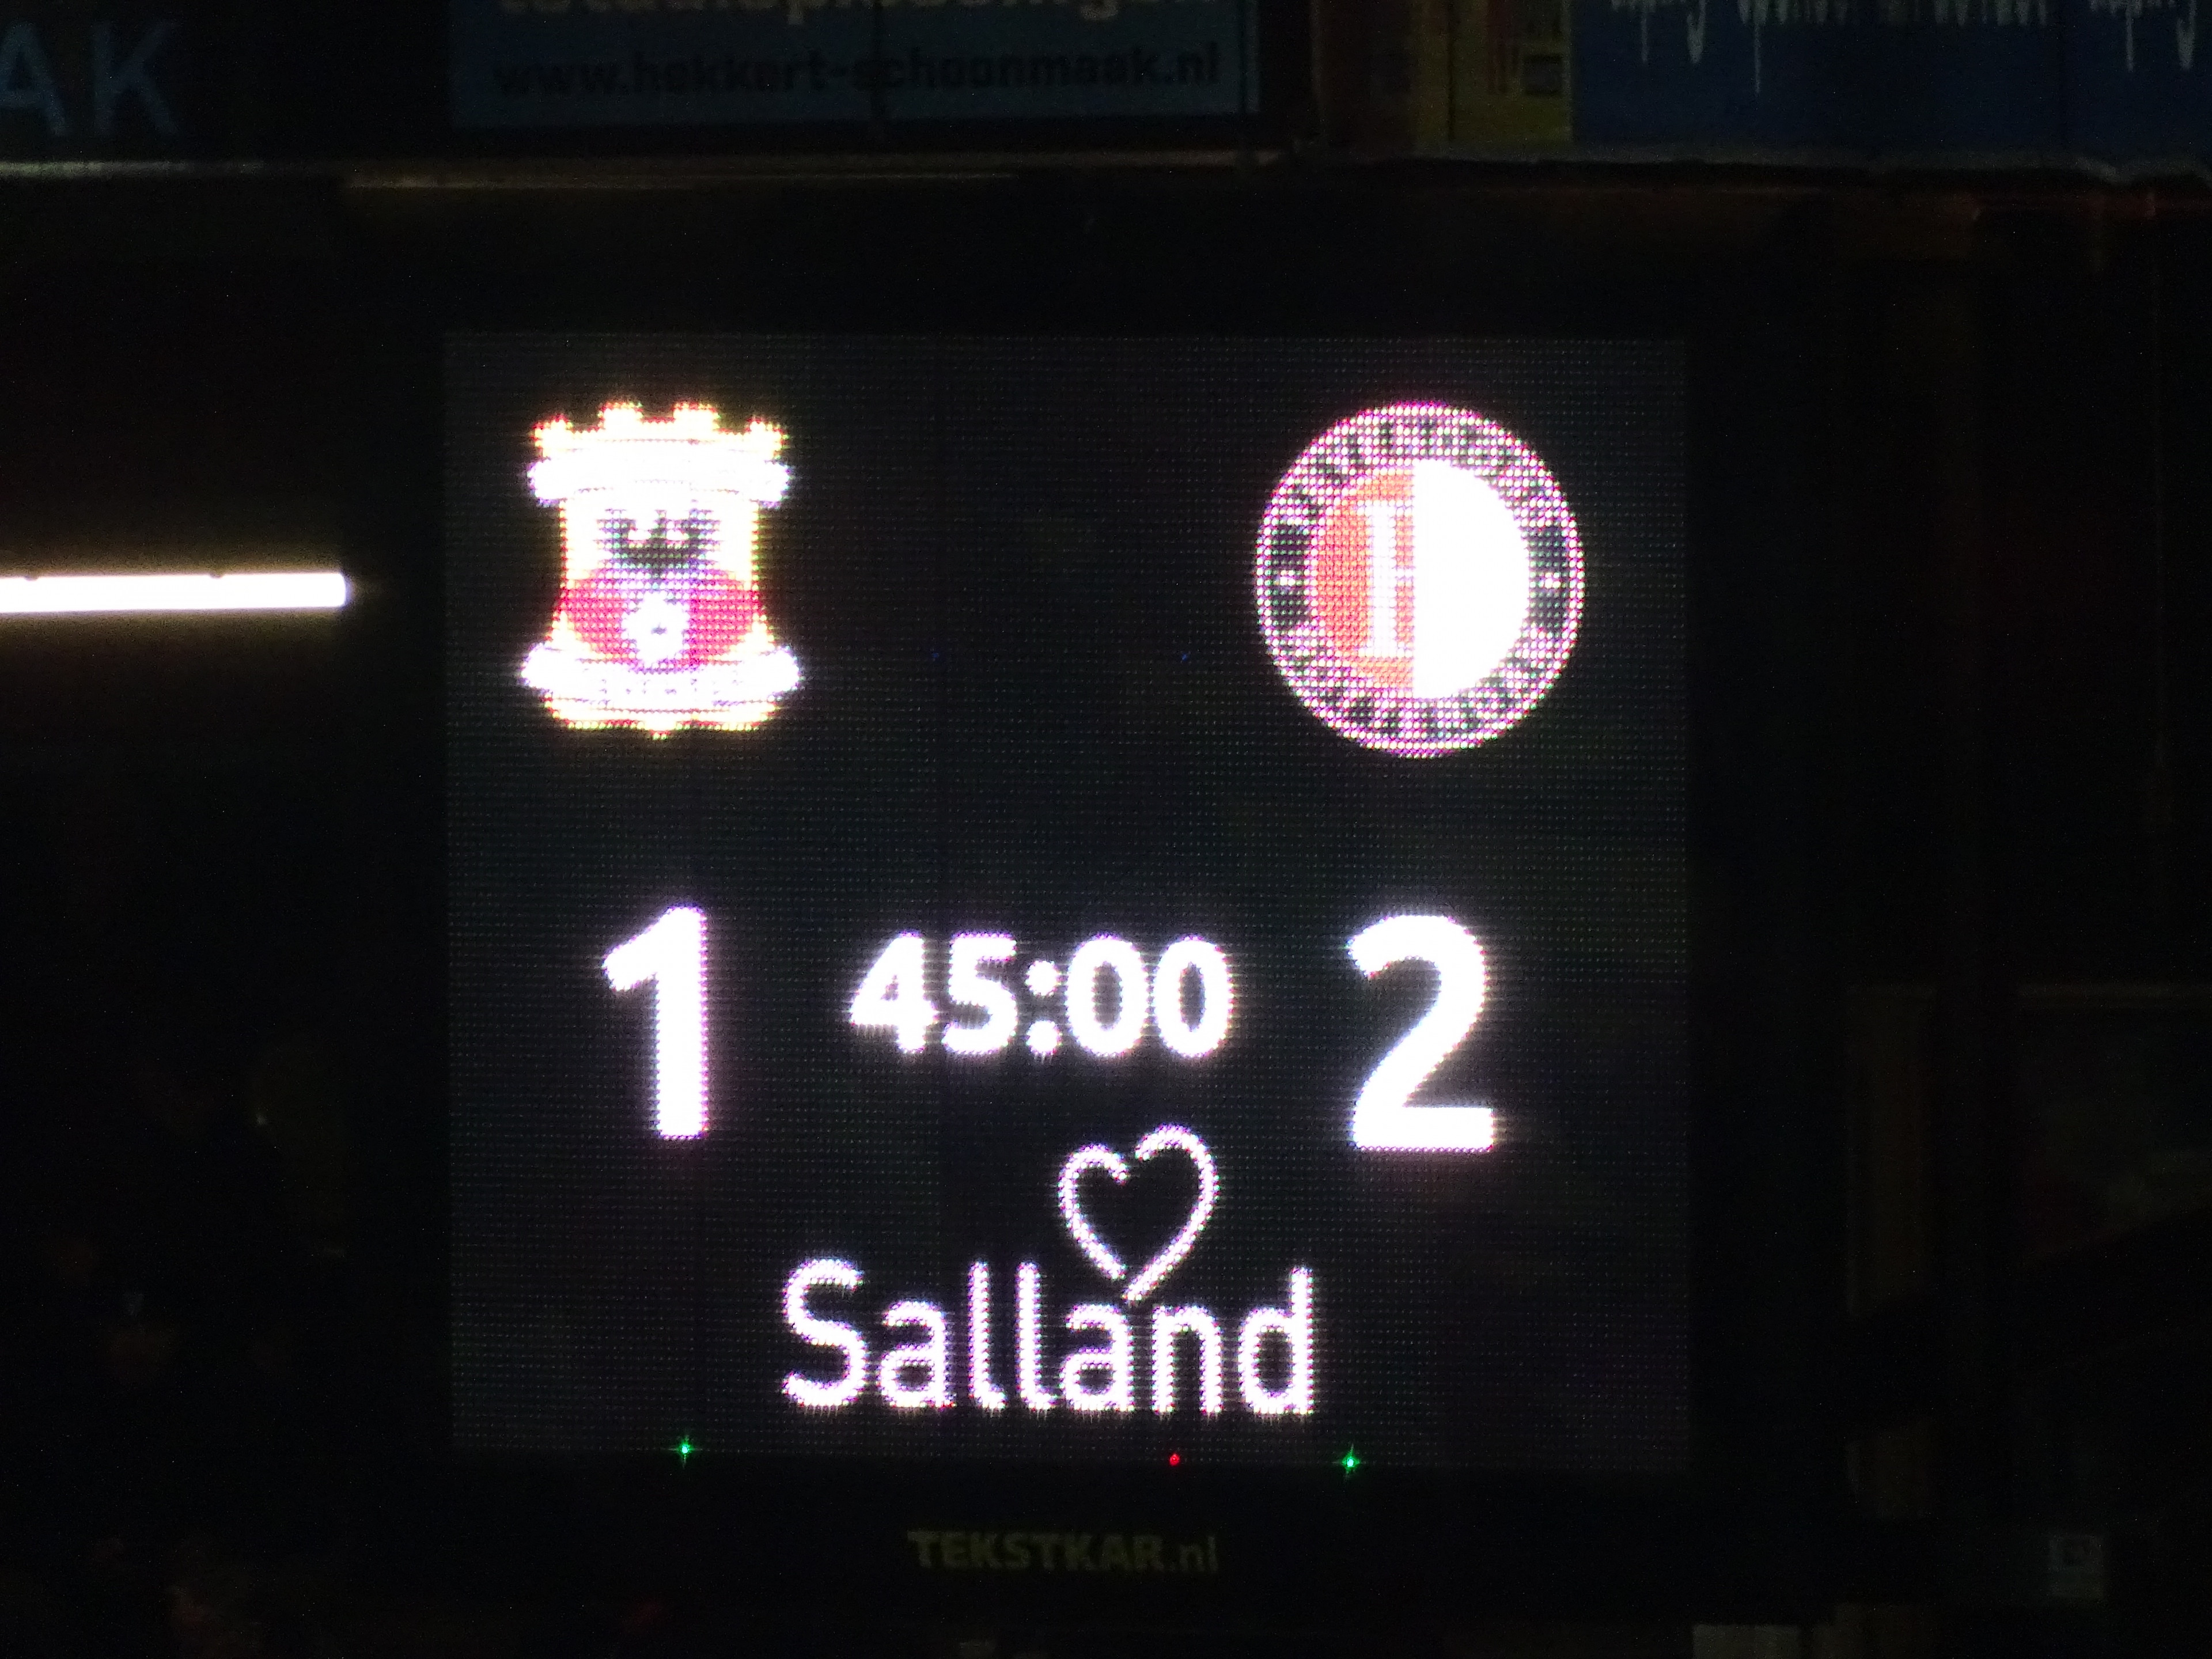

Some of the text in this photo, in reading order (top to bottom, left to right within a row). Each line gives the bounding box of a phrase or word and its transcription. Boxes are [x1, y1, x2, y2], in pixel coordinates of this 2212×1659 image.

[602, 905, 709, 1139] 1
[849, 930, 1234, 1057] 45:00
[1346, 915, 1495, 1152] 2
[782, 1258, 1315, 1415] Salland
[907, 1530, 1218, 1571] TEKSTKAR.nl
